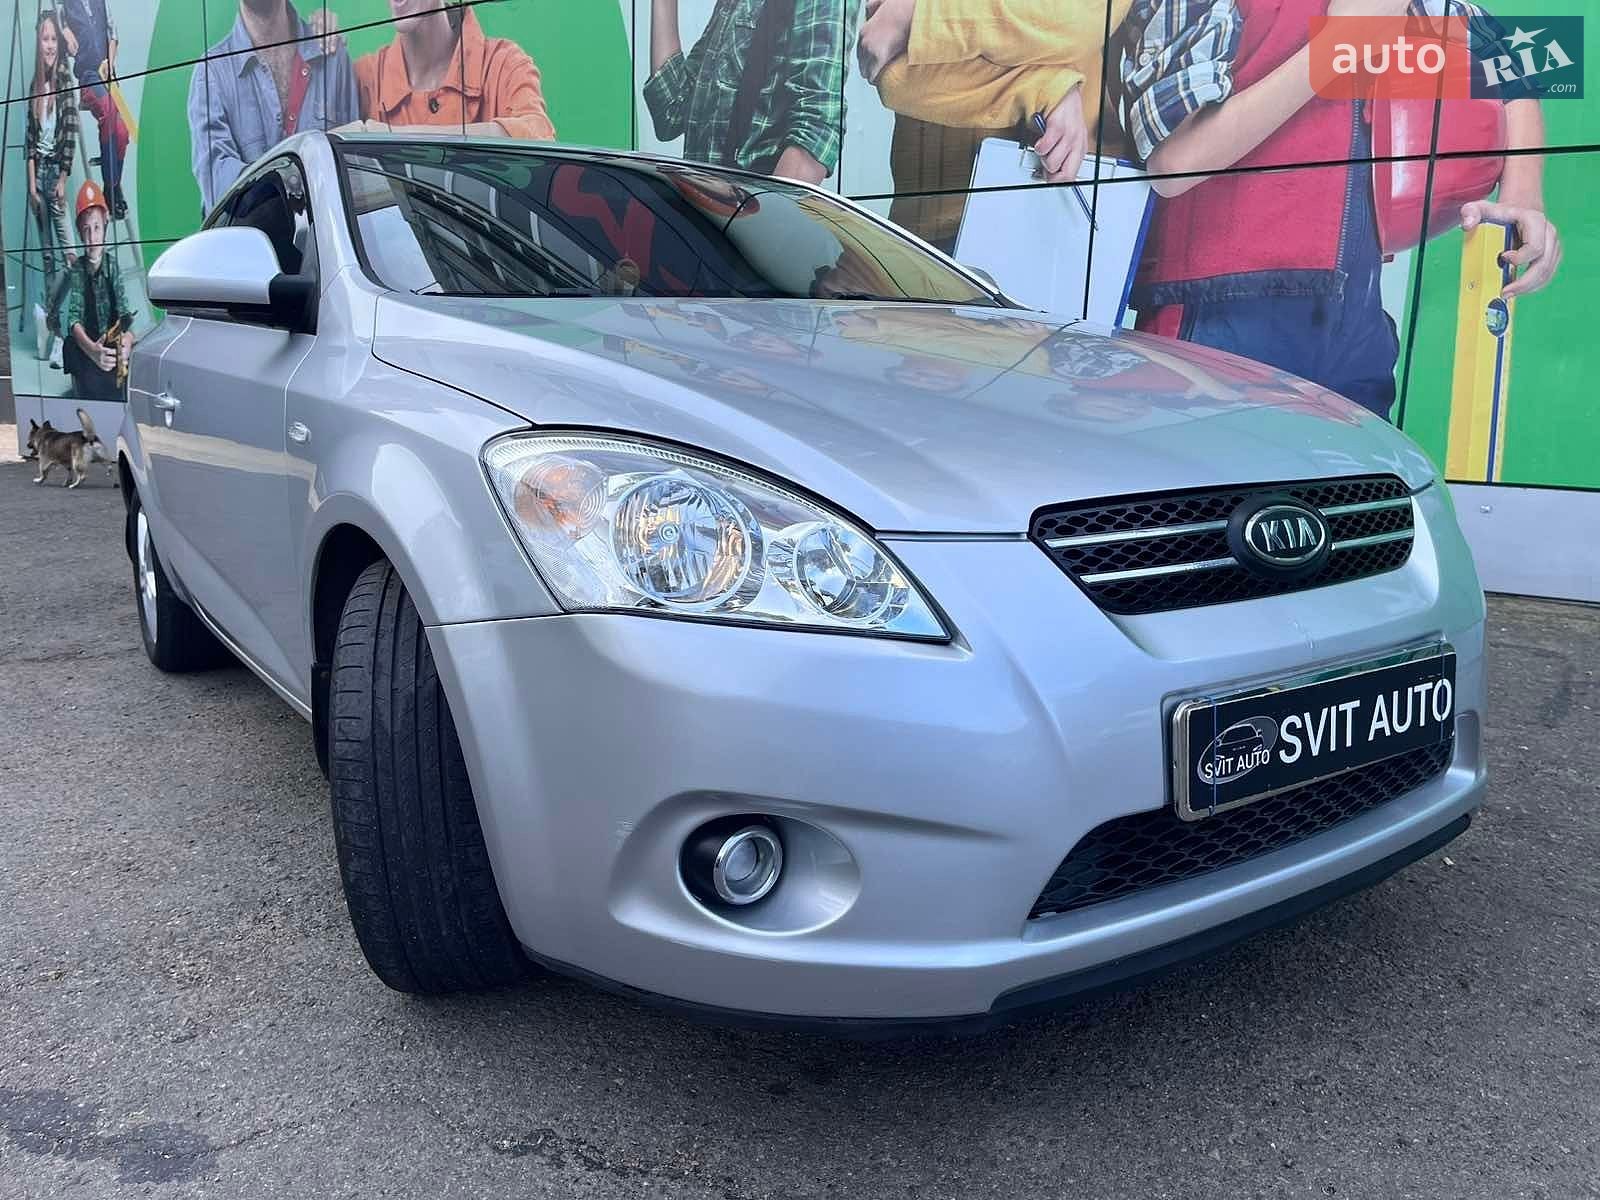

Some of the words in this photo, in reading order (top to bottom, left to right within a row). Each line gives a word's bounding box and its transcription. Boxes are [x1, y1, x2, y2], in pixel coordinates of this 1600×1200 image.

[1259, 517, 1317, 552] KIA
[1279, 700, 1360, 764] SVIT
[1368, 678, 1452, 741] AUTO
[1204, 757, 1234, 779] SVIT
[1236, 749, 1270, 771] AUTO
